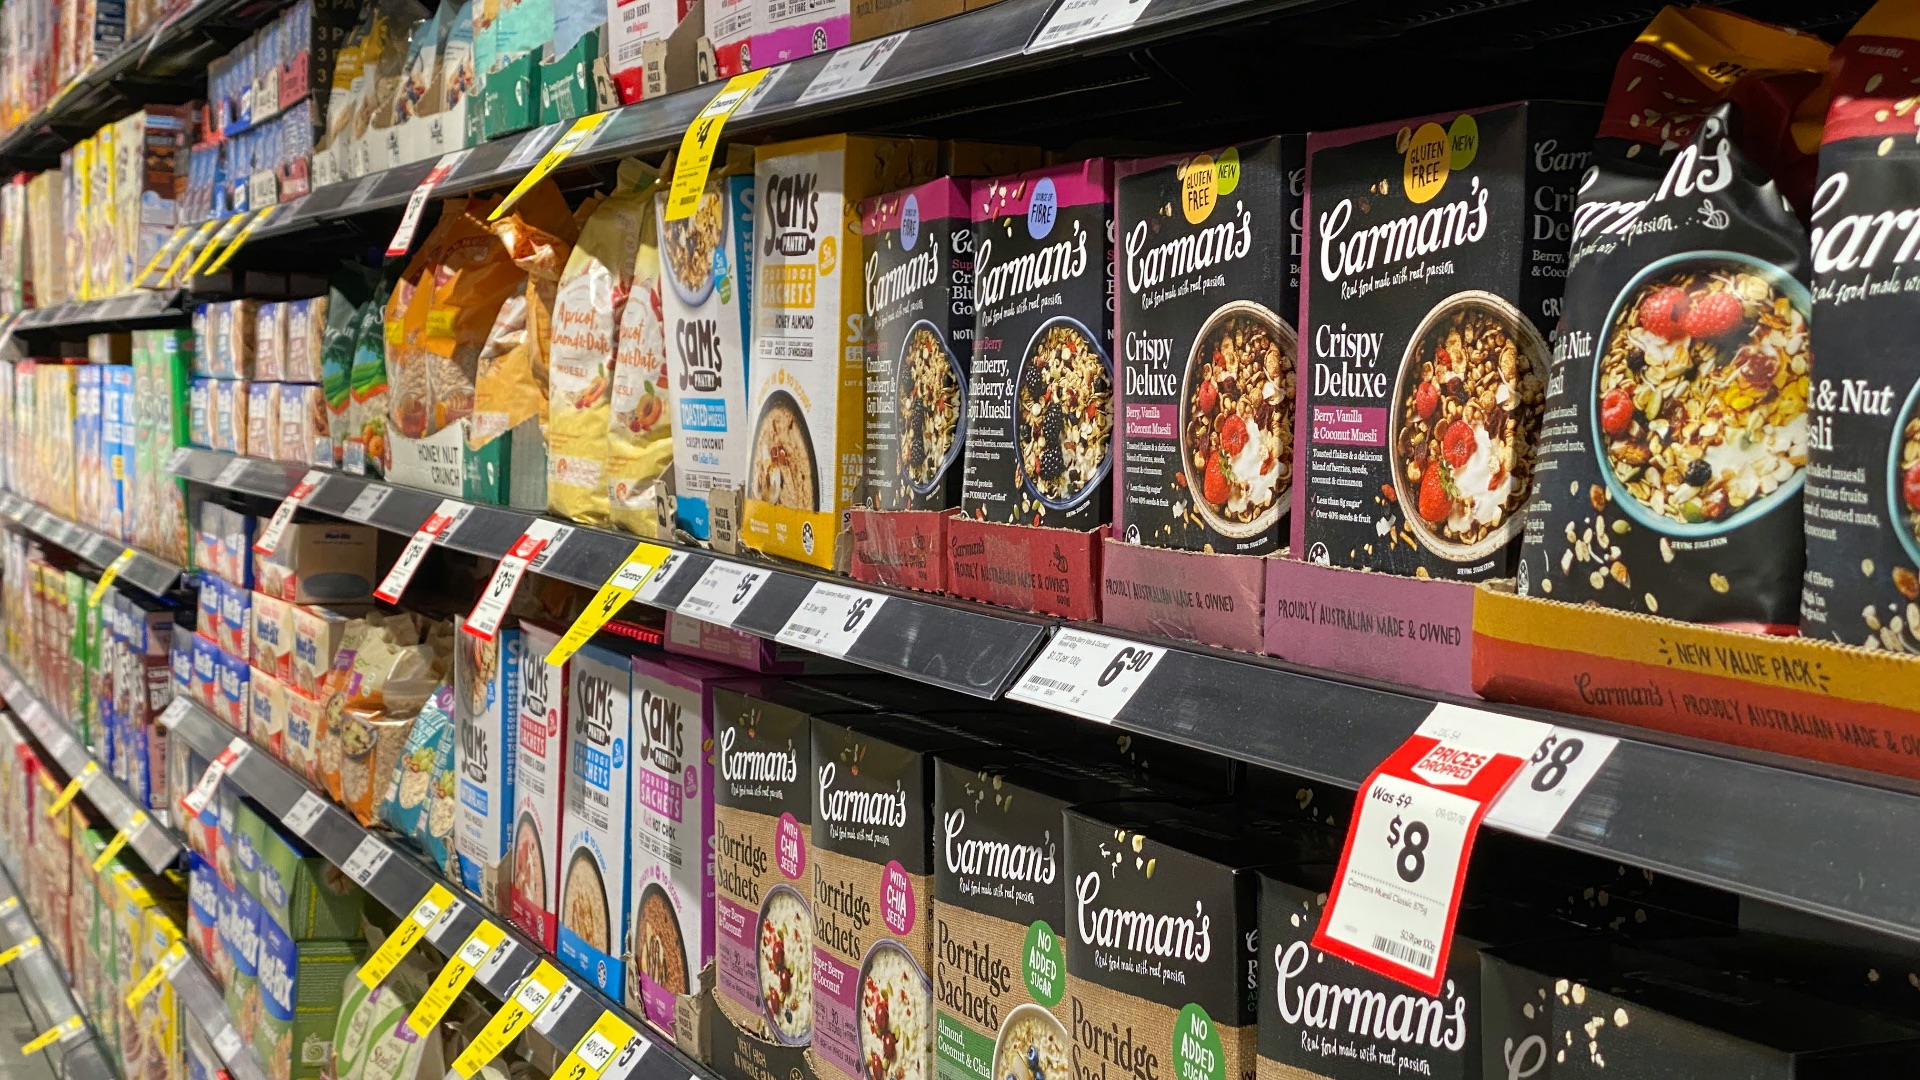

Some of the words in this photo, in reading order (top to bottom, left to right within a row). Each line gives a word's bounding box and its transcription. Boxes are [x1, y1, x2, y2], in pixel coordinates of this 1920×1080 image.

[1410, 140, 1445, 164] GLUTEN
[1451, 134, 1475, 152] NEW
[1186, 168, 1213, 190] GLUTEN
[1217, 164, 1237, 180] NEW
[1411, 160, 1440, 190] FREE
[1030, 203, 1052, 225] FIBRE
[1187, 187, 1210, 212] FREE
[902, 218, 917, 237] FIBRE
[1319, 175, 1489, 283] Carman's
[782, 235, 807, 252] PANTRY
[1125, 200, 1252, 295] Carman's
[1532, 250, 1565, 264] Berry,
[866, 232, 938, 317] Carman's
[974, 219, 1088, 312] Carman's
[1341, 281, 1358, 301] Real
[1358, 276, 1373, 299] food
[1374, 272, 1391, 290] made
[1391, 265, 1408, 287] with
[1408, 262, 1425, 281] real
[1425, 260, 1455, 285] passion
[762, 282, 812, 304] SACHETS
[558, 301, 599, 330] Apricot,
[791, 314, 814, 330] ALMOND
[984, 337, 1003, 352] Berry
[1125, 329, 1174, 370] Crispy
[1315, 322, 1384, 368] Crispy
[1565, 330, 1592, 360] Nut
[1125, 364, 1177, 397] Deluxe
[1313, 361, 1388, 399] Deluxe
[1816, 378, 1837, 413] &
[1838, 379, 1896, 416] Nut
[1126, 406, 1142, 420] Berry,
[1141, 406, 1160, 419] Vanilla
[1313, 408, 1336, 425] Berry,
[1336, 408, 1363, 424] Vanilla
[701, 437, 724, 451] COCONUT
[1312, 426, 1320, 440] &
[1319, 426, 1351, 441] Coconut
[1350, 427, 1378, 443] Muesli
[1311, 460, 1326, 471] blend
[1325, 462, 1333, 472] of
[1332, 462, 1351, 475] berries,
[1351, 464, 1369, 476] seeds,
[1311, 476, 1331, 485] coconut
[1331, 476, 1337, 485] &
[1336, 476, 1363, 488] cinnamon
[1832, 467, 1867, 484] muesli
[1316, 495, 1328, 506] Less
[1327, 496, 1340, 506] than
[1315, 509, 1328, 519] Over
[1328, 510, 1339, 520] 40%
[1338, 512, 1354, 522] seeds
[1353, 513, 1359, 523] &
[1358, 513, 1372, 524] fruit
[1819, 508, 1854, 524] roasted
[1854, 512, 1881, 530] nuts,
[731, 572, 760, 605] $5
[843, 596, 874, 633] $6
[1278, 599, 1317, 625] PROUDLY
[1319, 604, 1374, 634] AUSTRALIAN
[1376, 615, 1405, 638] MADE
[1407, 621, 1416, 640] &
[1419, 622, 1461, 648] OWNED
[1675, 642, 1712, 668] NEW
[1715, 646, 1769, 678] VALUE
[1771, 656, 1817, 688] PACK
[1574, 671, 1664, 708] Carman's
[1683, 692, 1741, 726] PROUDLY
[1747, 704, 1835, 741] AUSTRALIAN
[1836, 722, 1880, 750] MADE
[1884, 729, 1897, 754] &
[655, 748, 676, 772] PANTRY
[720, 726, 797, 784] Carman's
[1416, 758, 1475, 781] DROPPED
[1428, 745, 1488, 770] PRICES
[1530, 733, 1585, 793] $8
[641, 770, 681, 799] PORRIDGE
[818, 761, 907, 828] Carman's
[1372, 785, 1395, 805] Was
[1395, 791, 1413, 808] $9
[640, 782, 681, 820] SACHETS
[652, 814, 661, 832] HOT
[661, 821, 676, 841] CHOC
[783, 818, 798, 841] WITH
[717, 819, 768, 878] Porridge
[780, 834, 799, 864] CHIA
[944, 807, 1056, 885] Carman's
[1386, 814, 1431, 884] $8
[717, 853, 759, 907] Sachets
[780, 855, 798, 878] SEEDS
[889, 867, 907, 892] WITH
[813, 862, 871, 931] Porridge
[886, 883, 908, 918] CHIA
[1347, 877, 1374, 895] Carmans
[1374, 887, 1393, 901] Muesli
[1392, 893, 1413, 909] Classic
[1412, 900, 1429, 917] 875g
[813, 900, 862, 961] Sachets
[886, 908, 906, 932] SEEDS
[1076, 871, 1211, 963] Carman's
[1037, 927, 1052, 950] NO
[813, 950, 828, 973] Super
[827, 959, 845, 985] Berry
[937, 919, 1011, 998] Porridge
[1028, 945, 1058, 982] ADDED
[1094, 949, 1108, 969] Real
[1108, 952, 1120, 972] food
[1120, 955, 1135, 972] made
[1135, 957, 1149, 976] with
[1148, 961, 1162, 979] real
[1161, 967, 1186, 987] passion
[937, 962, 999, 1032] Sachets
[1029, 971, 1053, 999] SUGAR
[1274, 940, 1467, 1051] Carman's
[938, 1018, 965, 1047] Almond,
[1071, 995, 1159, 1080] Porridge
[1191, 1012, 1208, 1040] NO
[585, 1038, 599, 1055] 40%
[594, 1046, 610, 1061] OFF
[618, 1035, 643, 1068] $5
[938, 1036, 966, 1065] Coconut
[965, 1053, 973, 1067] &
[973, 1057, 991, 1080] Chia
[1181, 1031, 1215, 1074] ADDED
[1301, 1030, 1319, 1052] Real
[1320, 1035, 1339, 1057] food
[1338, 1040, 1359, 1060] made
[1359, 1041, 1378, 1064] with
[1377, 1046, 1397, 1067] real
[1397, 1049, 1432, 1077] passion
